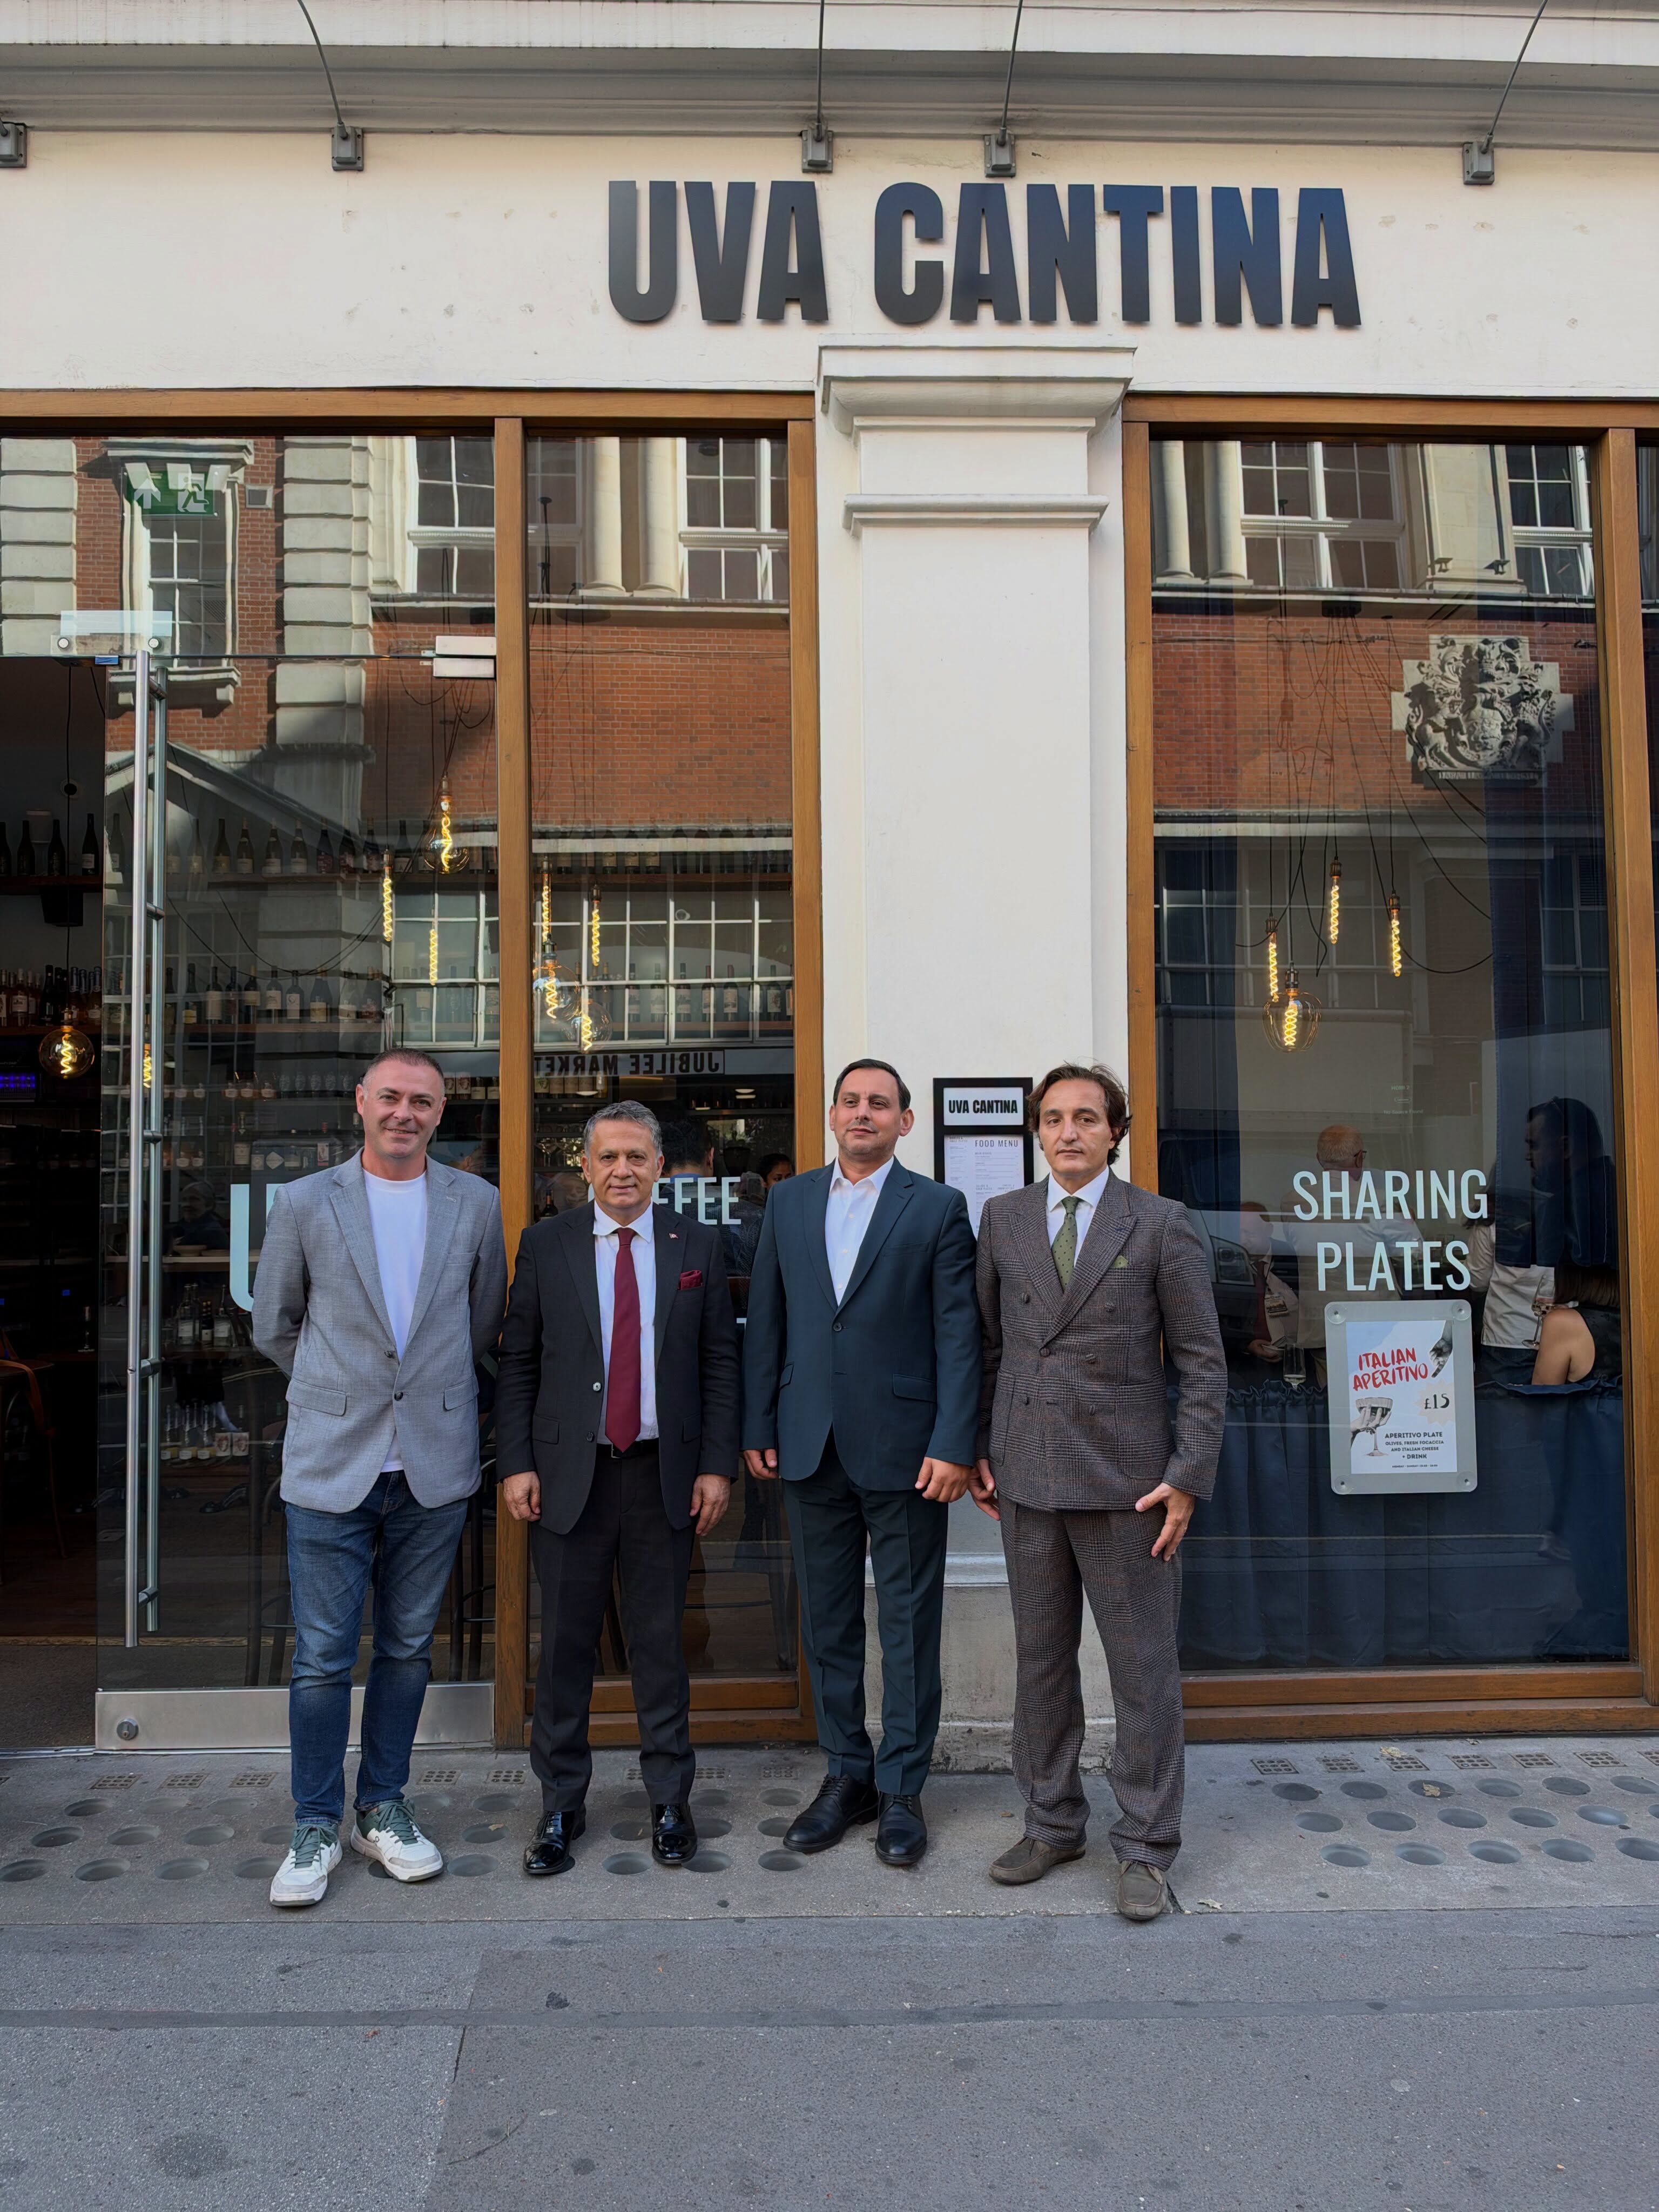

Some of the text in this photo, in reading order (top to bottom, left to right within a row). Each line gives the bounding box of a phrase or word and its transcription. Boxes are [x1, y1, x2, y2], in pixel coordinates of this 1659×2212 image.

[608, 180, 1362, 326] UVA CANTINA
[948, 1100, 1018, 1114] UVA CANTINA
[588, 1177, 741, 1225] FFEE
[1293, 1169, 1488, 1221] SHARING
[1317, 1240, 1471, 1291] PLATES
[1353, 1363, 1428, 1392] APERITIVO
[1358, 1347, 1417, 1371] ITALIAN
[1424, 1393, 1450, 1410] £15
